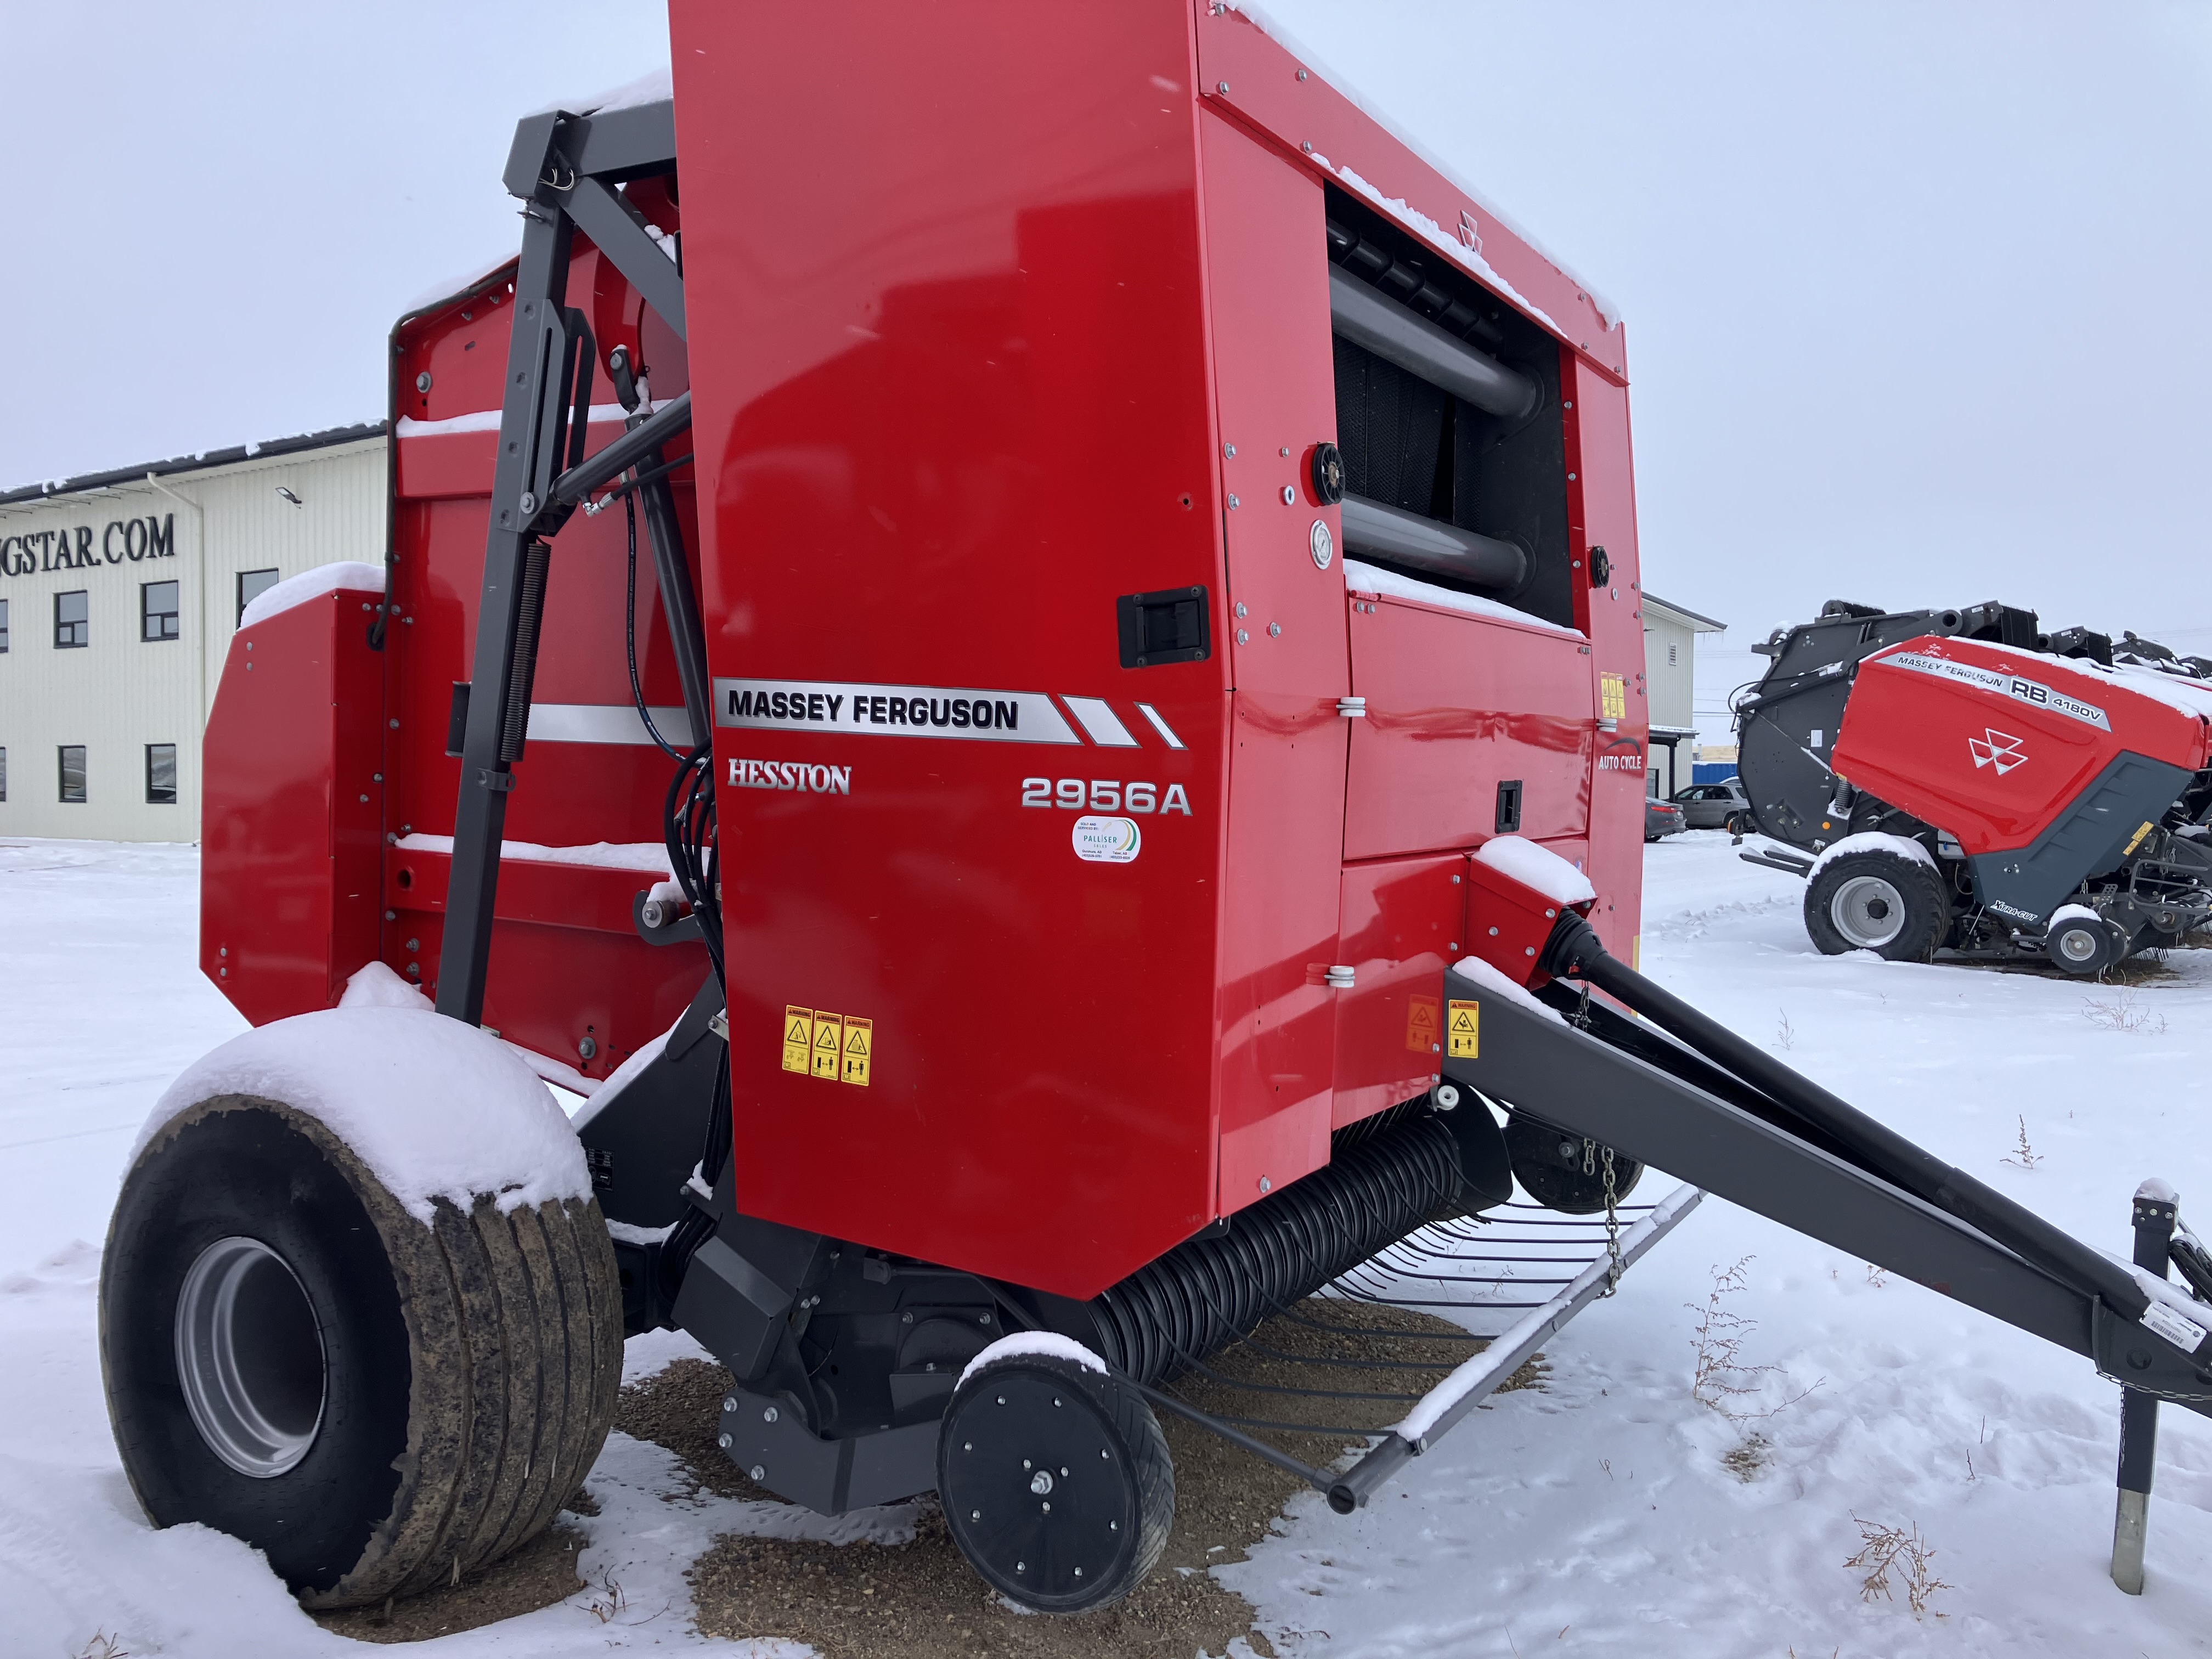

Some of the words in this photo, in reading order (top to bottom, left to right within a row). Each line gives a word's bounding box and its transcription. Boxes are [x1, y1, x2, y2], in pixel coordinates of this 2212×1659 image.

[0, 513, 174, 577] GSTAR.COM
[1898, 657, 1942, 669] MASSEY
[1945, 666, 2003, 687] FERGUSON
[2011, 679, 2048, 704] RB
[2052, 698, 2102, 721] 4180V
[729, 690, 843, 721] MASSEY
[853, 695, 1019, 730] FERGUSON
[727, 758, 852, 794] HESSTON
[1598, 756, 1619, 770] AUTO
[1620, 755, 1641, 769] CYCLE
[1022, 777, 1193, 816] 2956A
[1084, 834, 1117, 843] PALLISER
[1991, 900, 2038, 921] XTRA-CUT
